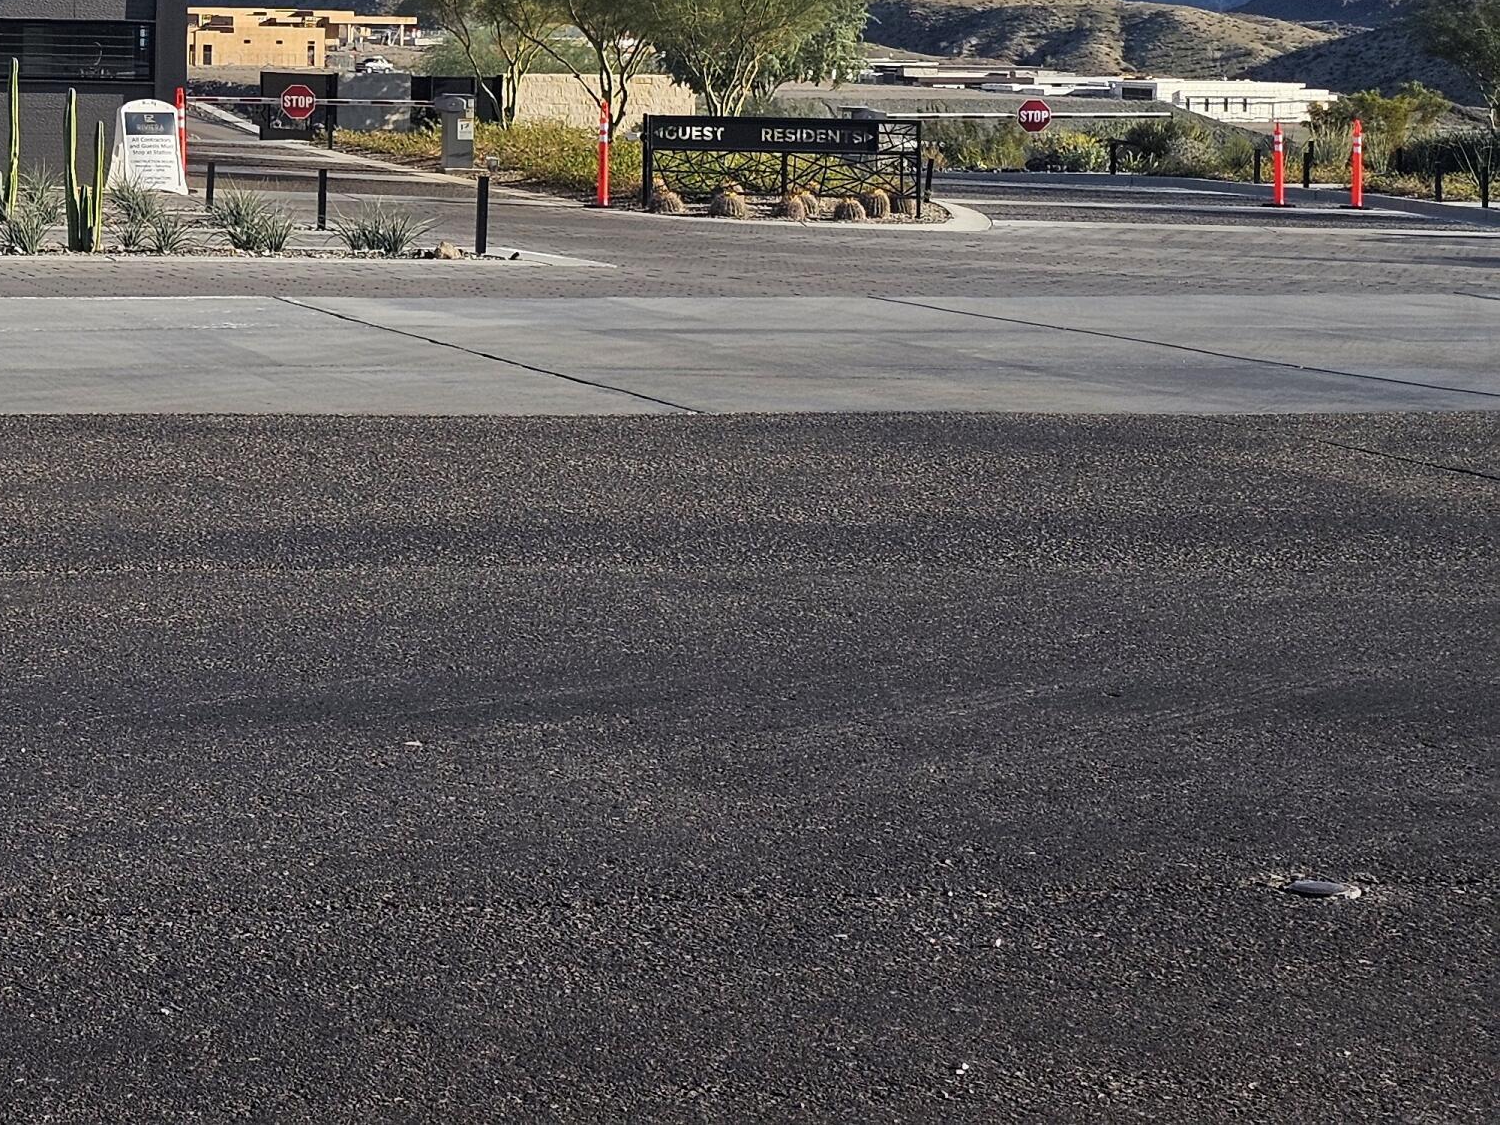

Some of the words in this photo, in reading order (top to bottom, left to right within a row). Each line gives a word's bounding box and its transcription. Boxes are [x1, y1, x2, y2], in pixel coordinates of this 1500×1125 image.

[283, 95, 313, 108] STOP
[1020, 110, 1049, 123] STOP
[665, 126, 725, 141] GUEST
[761, 128, 863, 145] RESIDENTS
